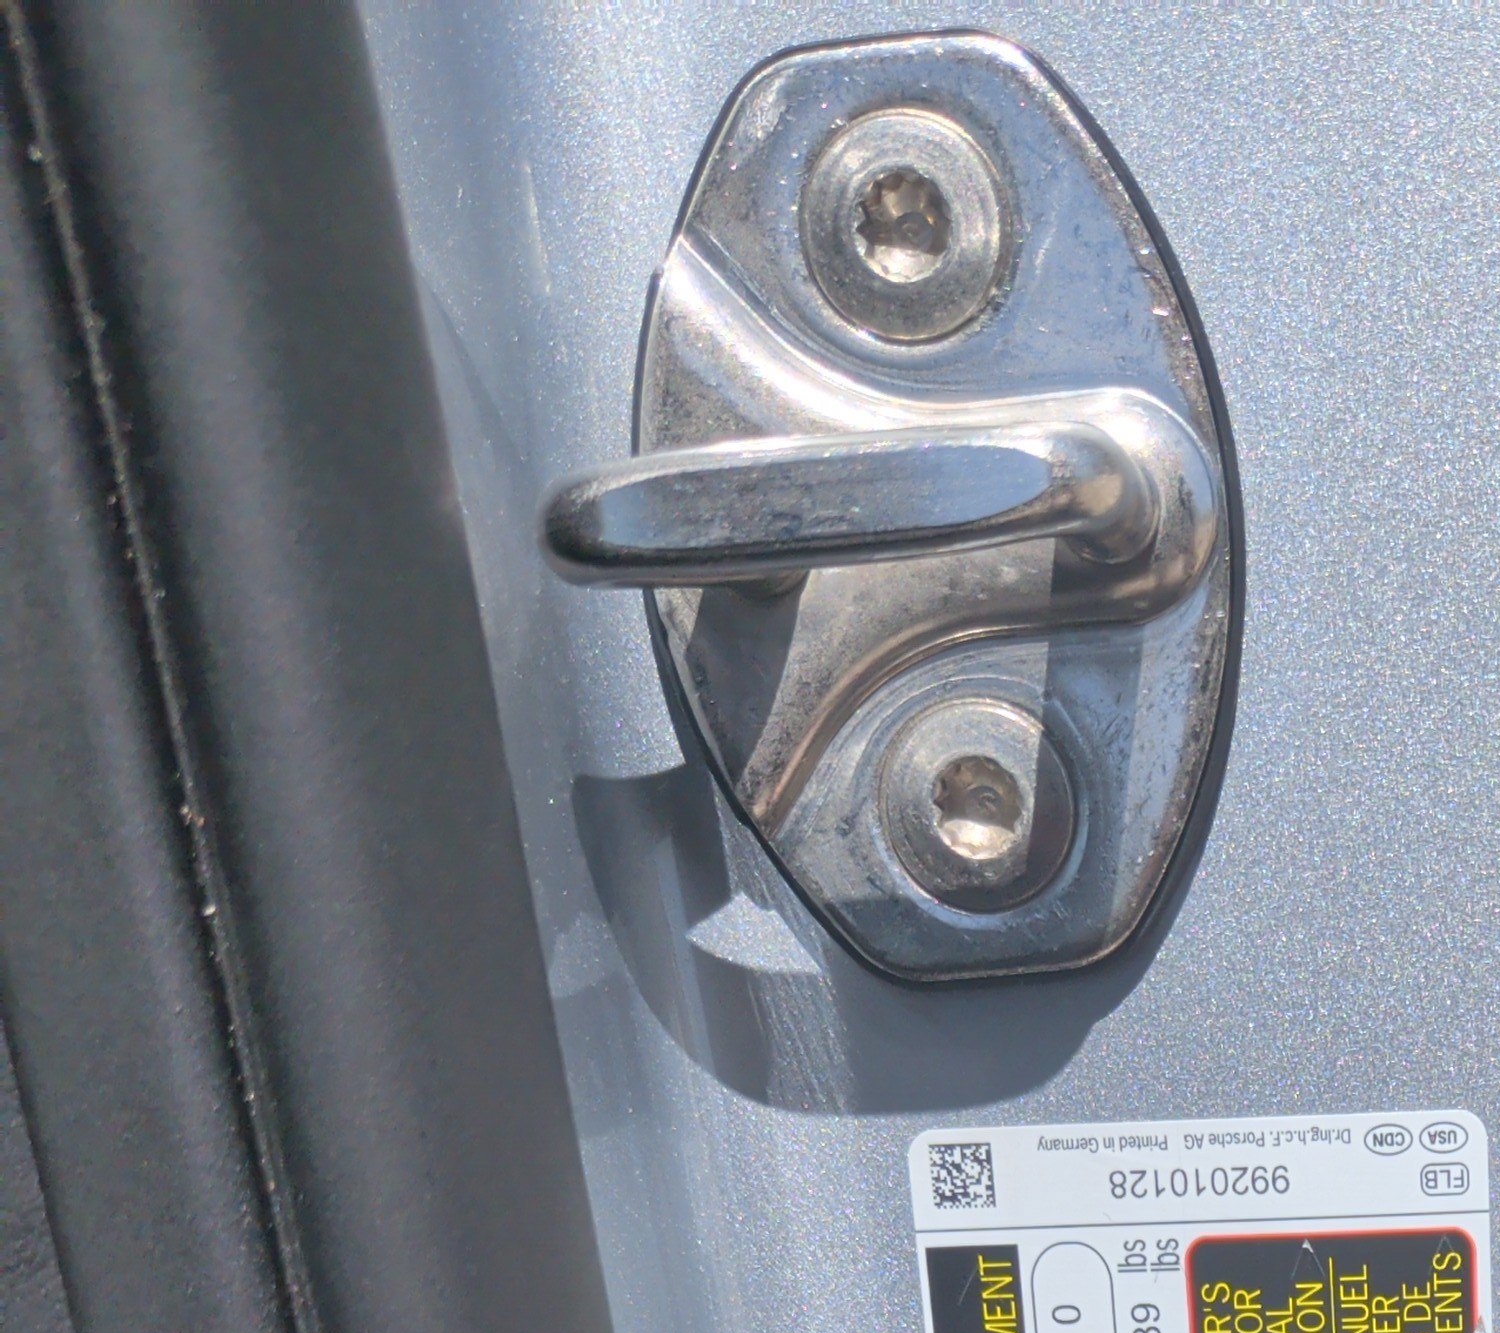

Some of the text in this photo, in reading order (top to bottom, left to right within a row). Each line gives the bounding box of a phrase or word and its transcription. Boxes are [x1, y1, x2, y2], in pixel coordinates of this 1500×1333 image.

[1036, 1134, 1168, 1154] Printed in Germany
[1182, 1132, 1205, 1151] AG
[1207, 1130, 1266, 1149] Porsche
[1372, 1125, 1405, 1147] CDN
[1424, 1125, 1457, 1145] USA
[1107, 1163, 1290, 1200] 992010128
[1421, 1166, 1465, 1192] FLB
[1116, 1238, 1148, 1274] lbs
[1148, 1237, 1181, 1273] lbs
[1401, 1280, 1432, 1322] DE
[1050, 1303, 1082, 1325] 0
